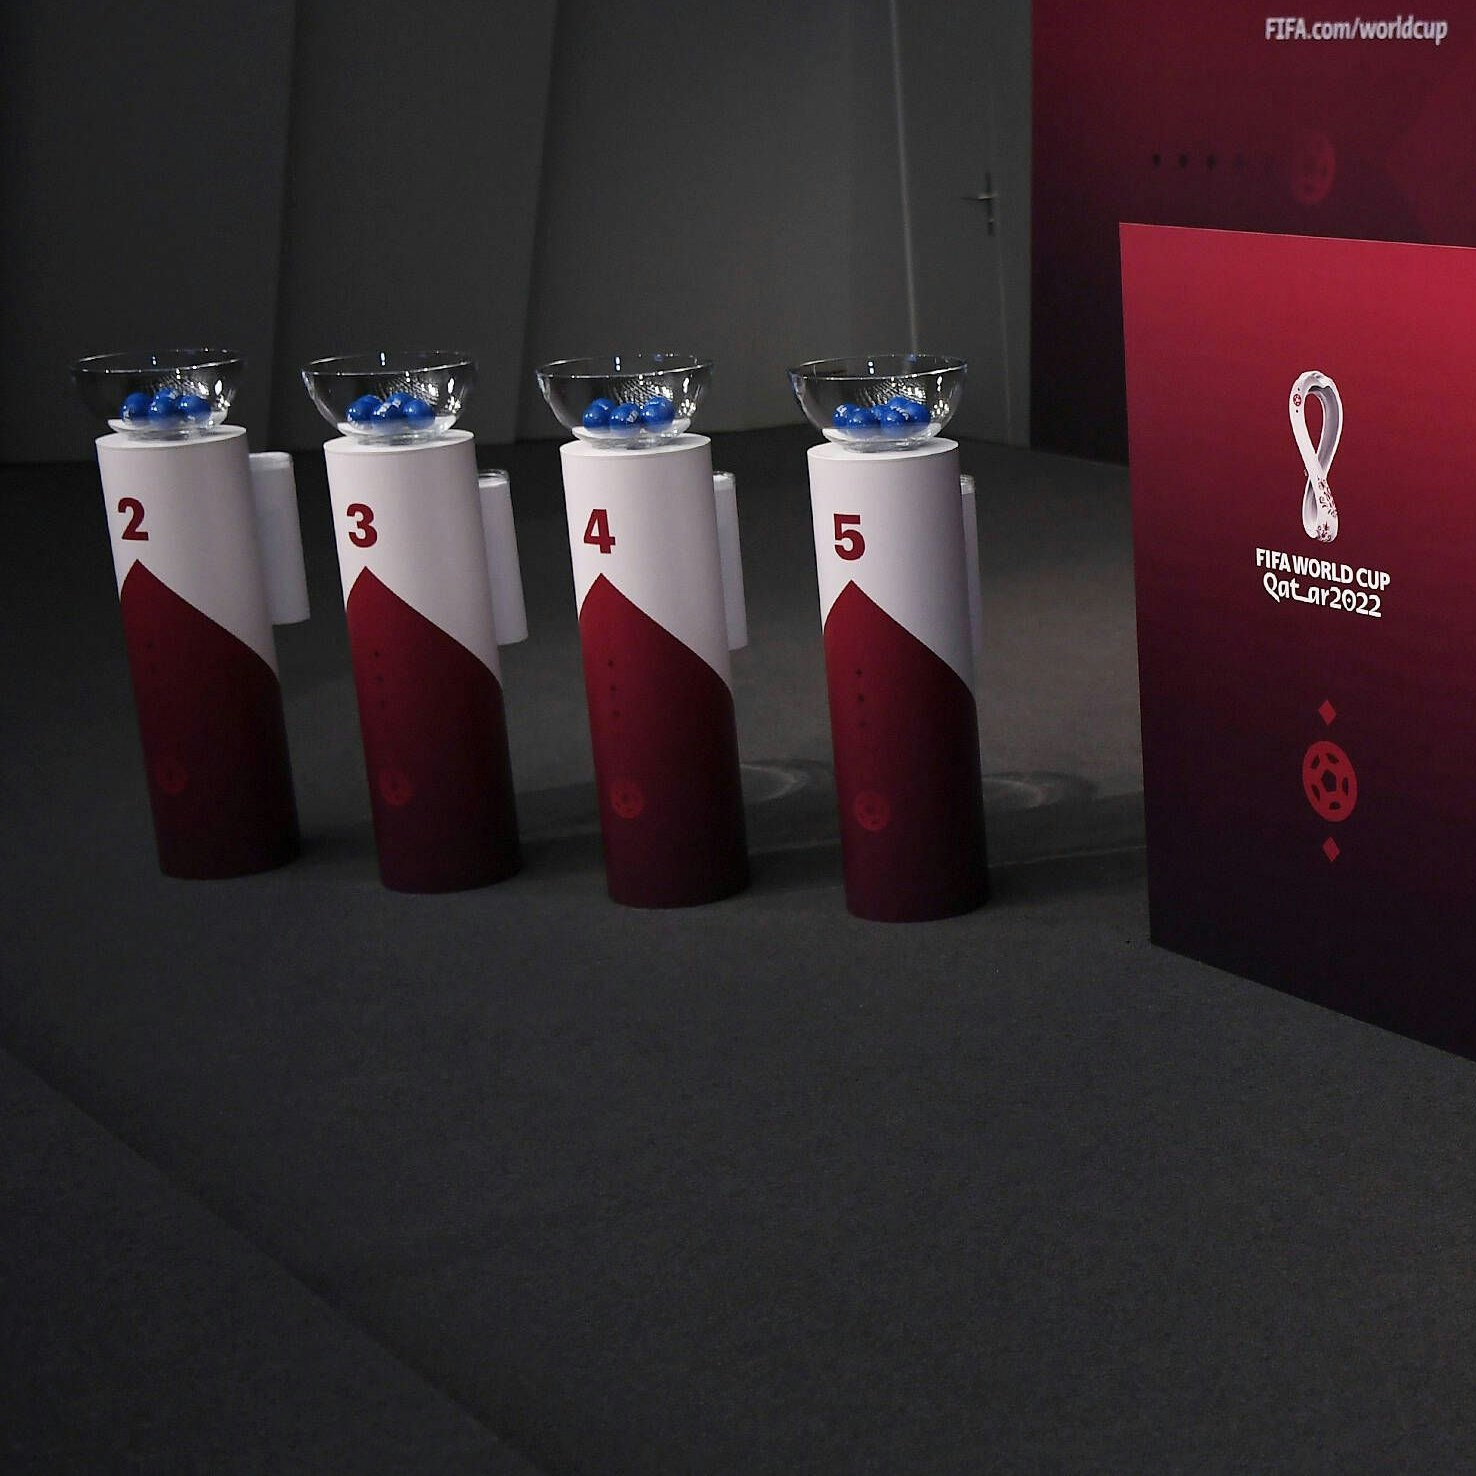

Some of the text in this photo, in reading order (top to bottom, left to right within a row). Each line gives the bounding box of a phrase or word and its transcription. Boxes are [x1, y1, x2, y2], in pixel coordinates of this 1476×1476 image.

[1265, 15, 1448, 46] FIFA.com/worldcup
[117, 497, 150, 542] 2
[346, 503, 378, 549] 3
[583, 508, 616, 555] 4
[833, 513, 866, 561] 5
[1255, 547, 1391, 591] FIFA WORLD CUP
